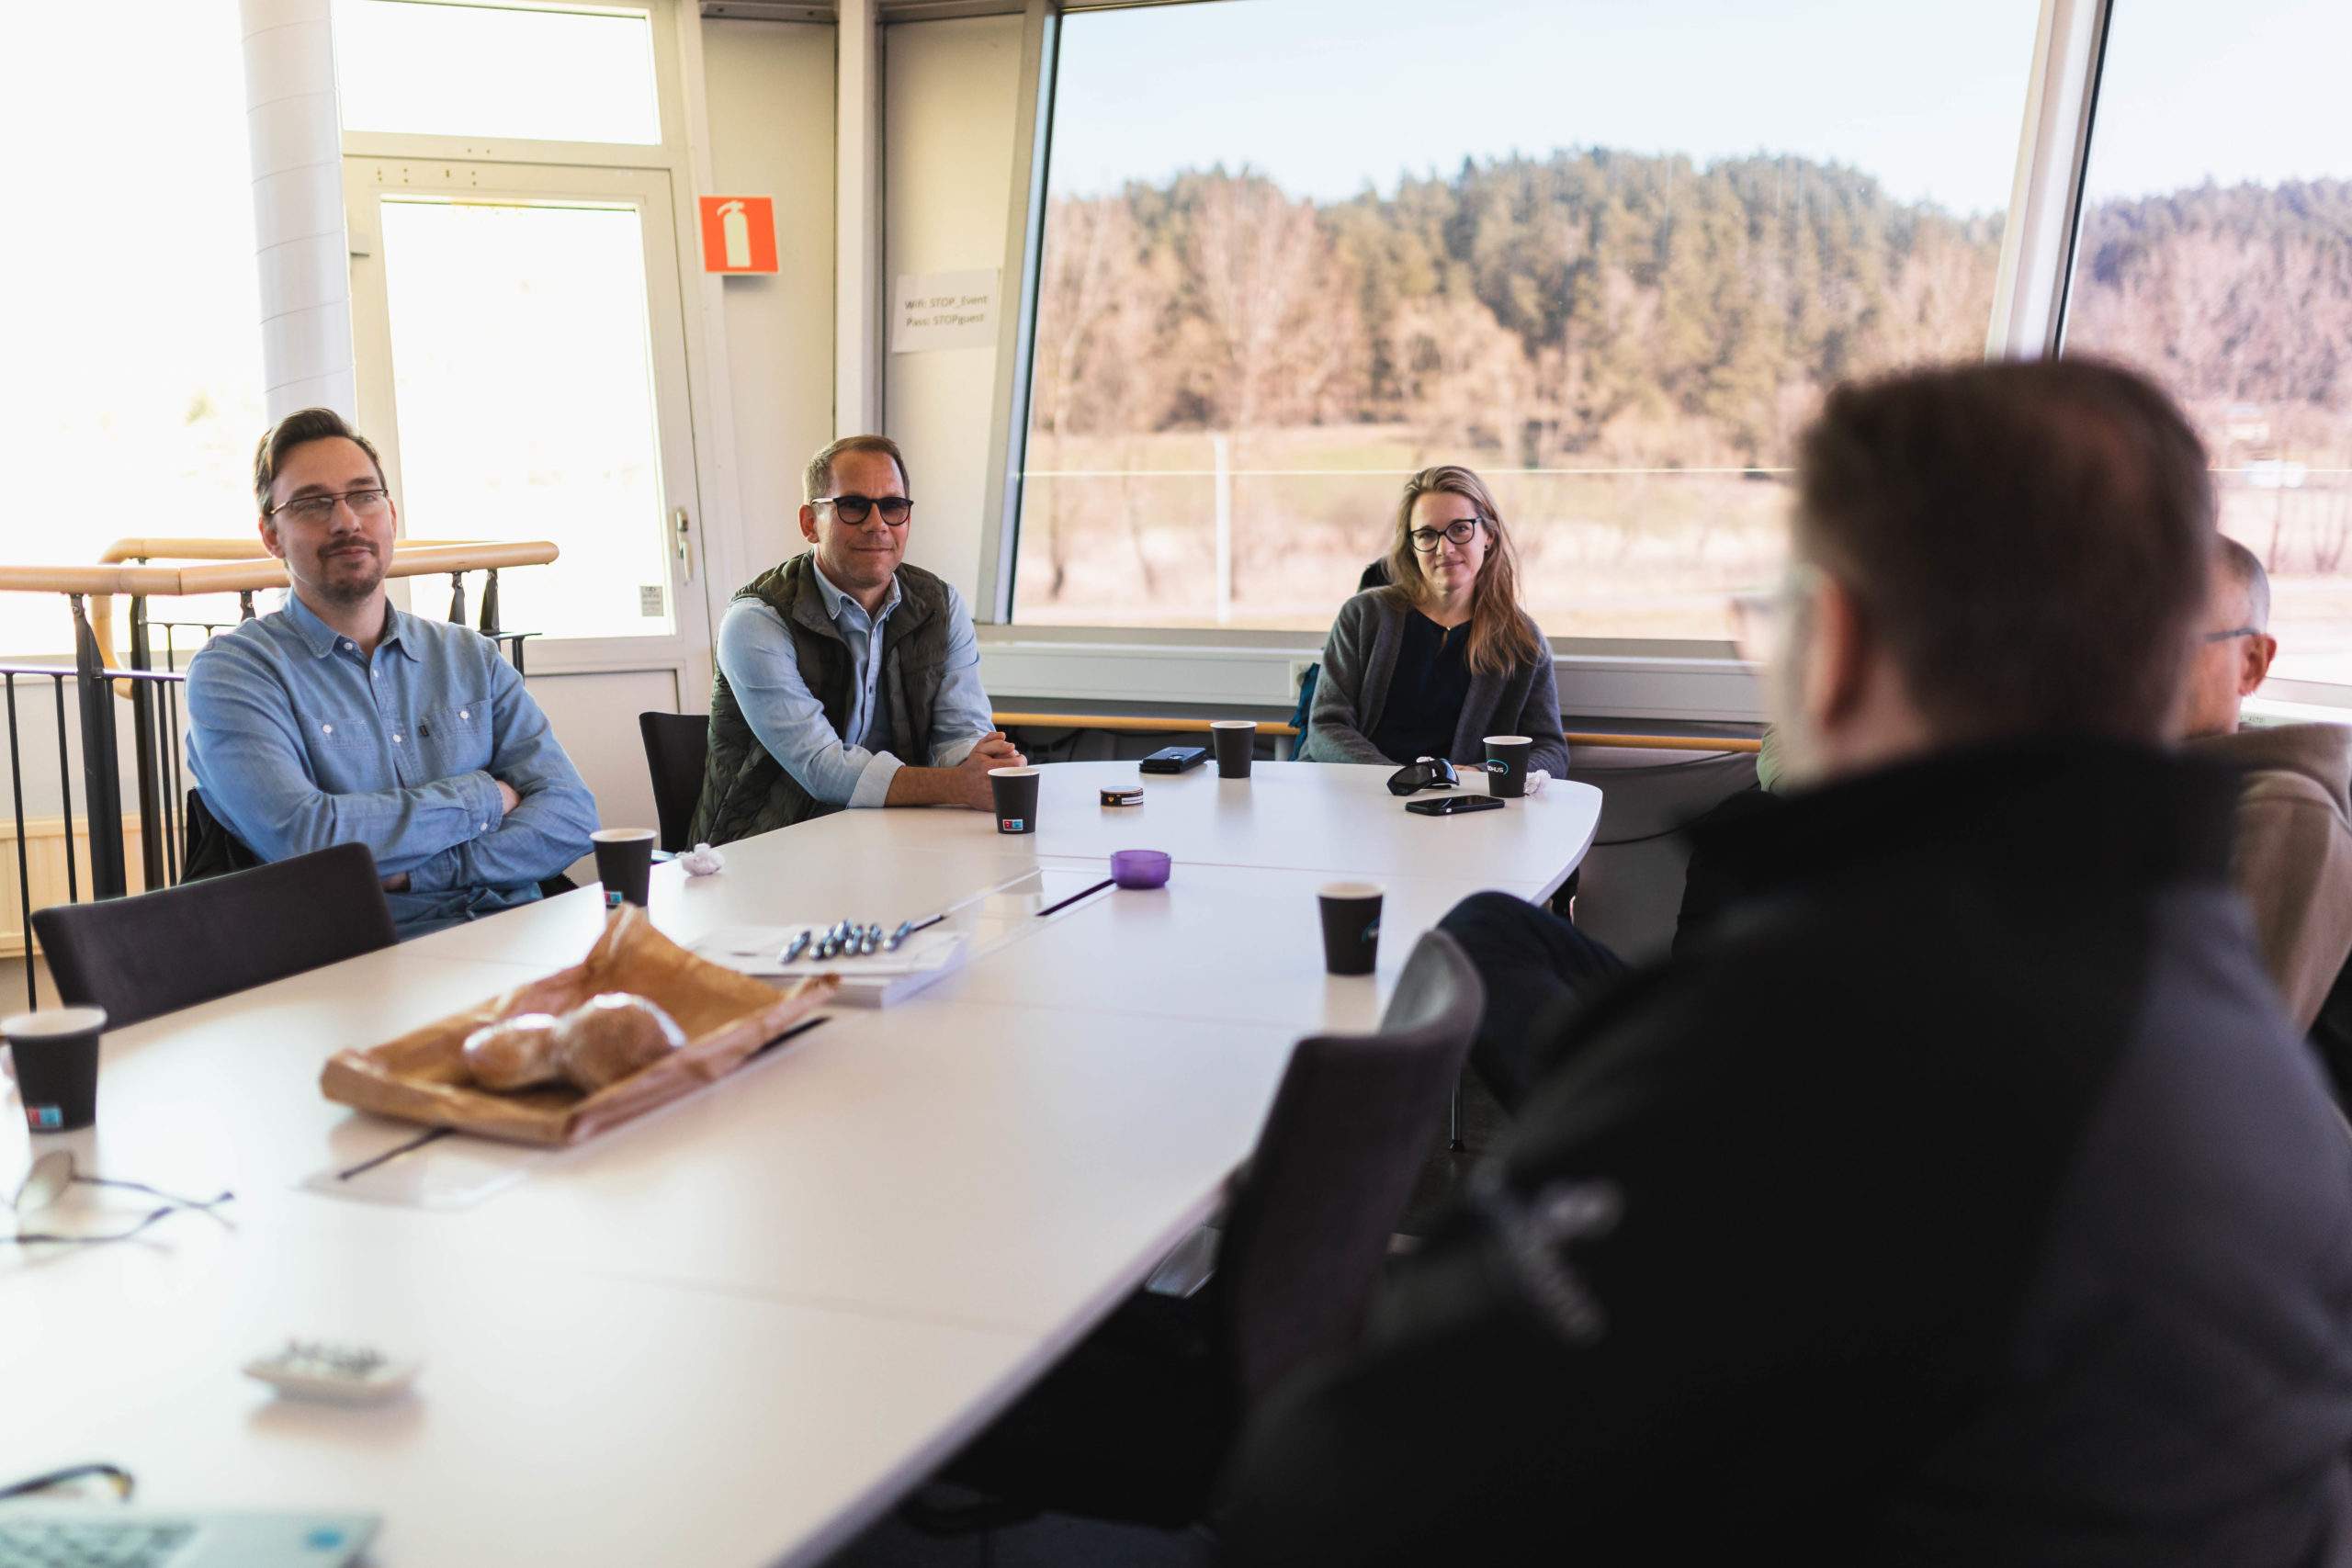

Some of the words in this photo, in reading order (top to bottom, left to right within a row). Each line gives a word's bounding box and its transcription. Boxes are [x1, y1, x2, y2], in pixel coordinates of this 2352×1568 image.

[905, 299, 926, 310] Wifi:
[930, 295, 988, 309] STOP_Event
[906, 316, 930, 327] Pass:
[933, 313, 985, 325] STOPguest
